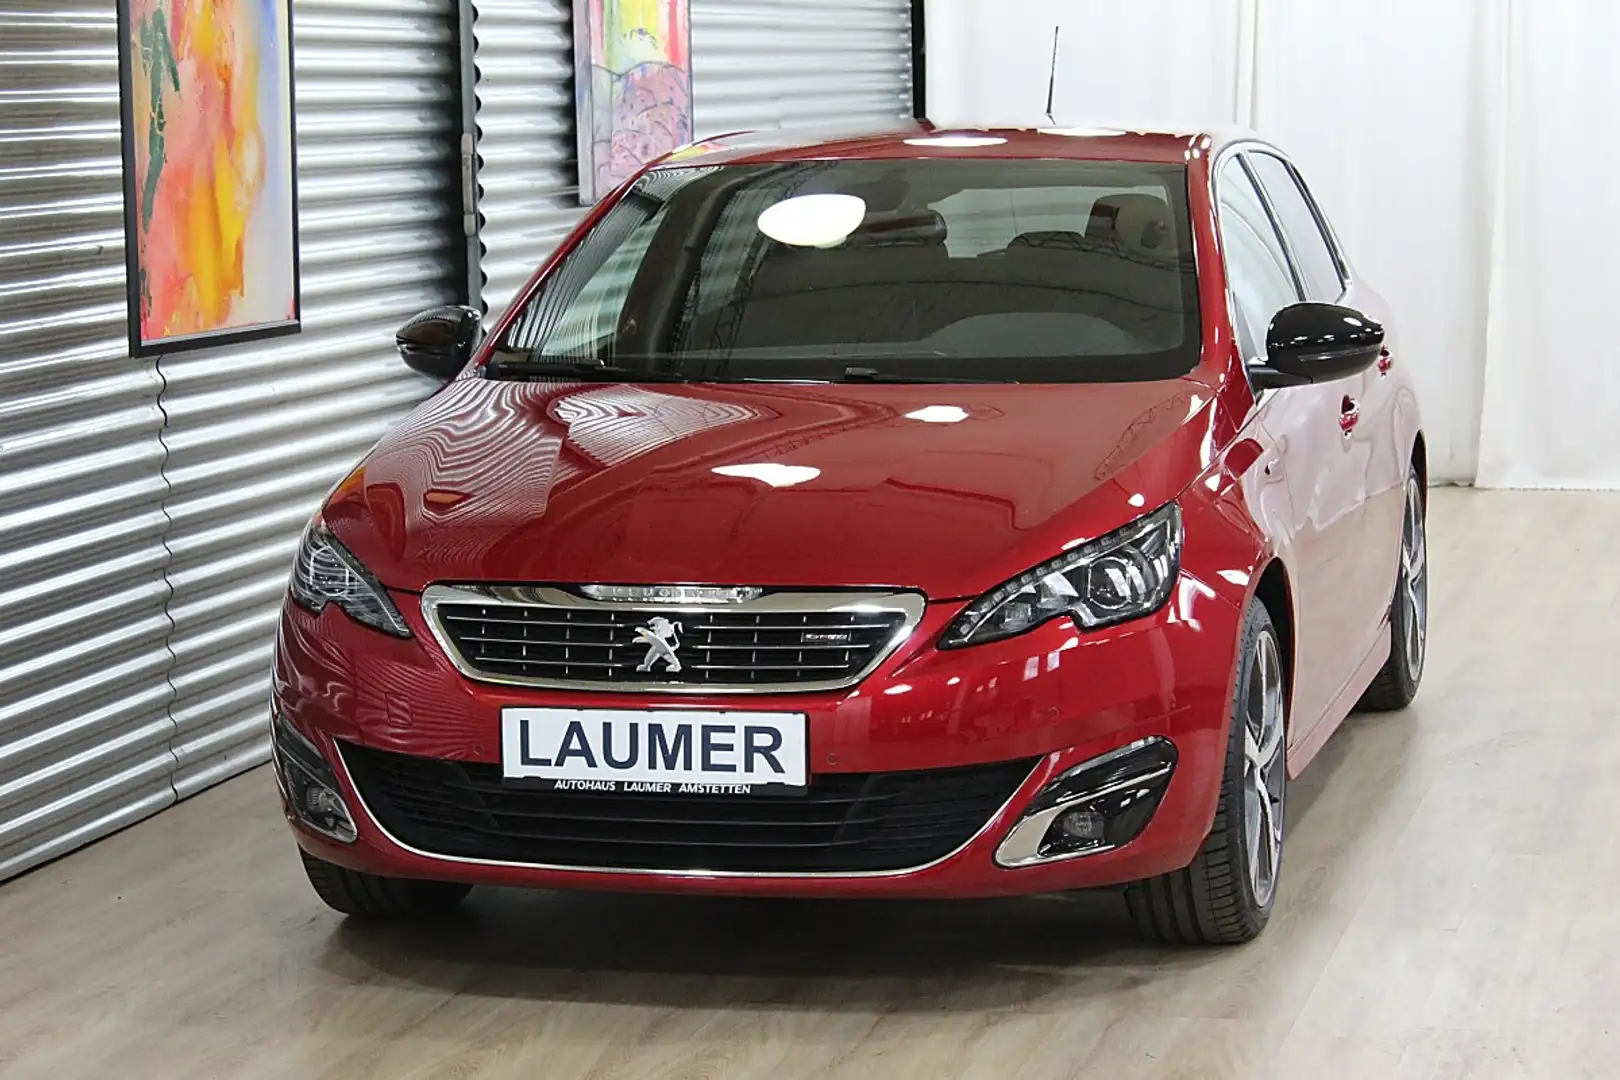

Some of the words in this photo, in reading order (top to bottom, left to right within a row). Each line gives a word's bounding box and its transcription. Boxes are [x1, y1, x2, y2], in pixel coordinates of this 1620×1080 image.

[519, 719, 786, 774] LAUMER
[554, 780, 616, 791] AUTOHAUS
[623, 782, 672, 792] LAUMER
[678, 783, 751, 794] AMSTETTEN
